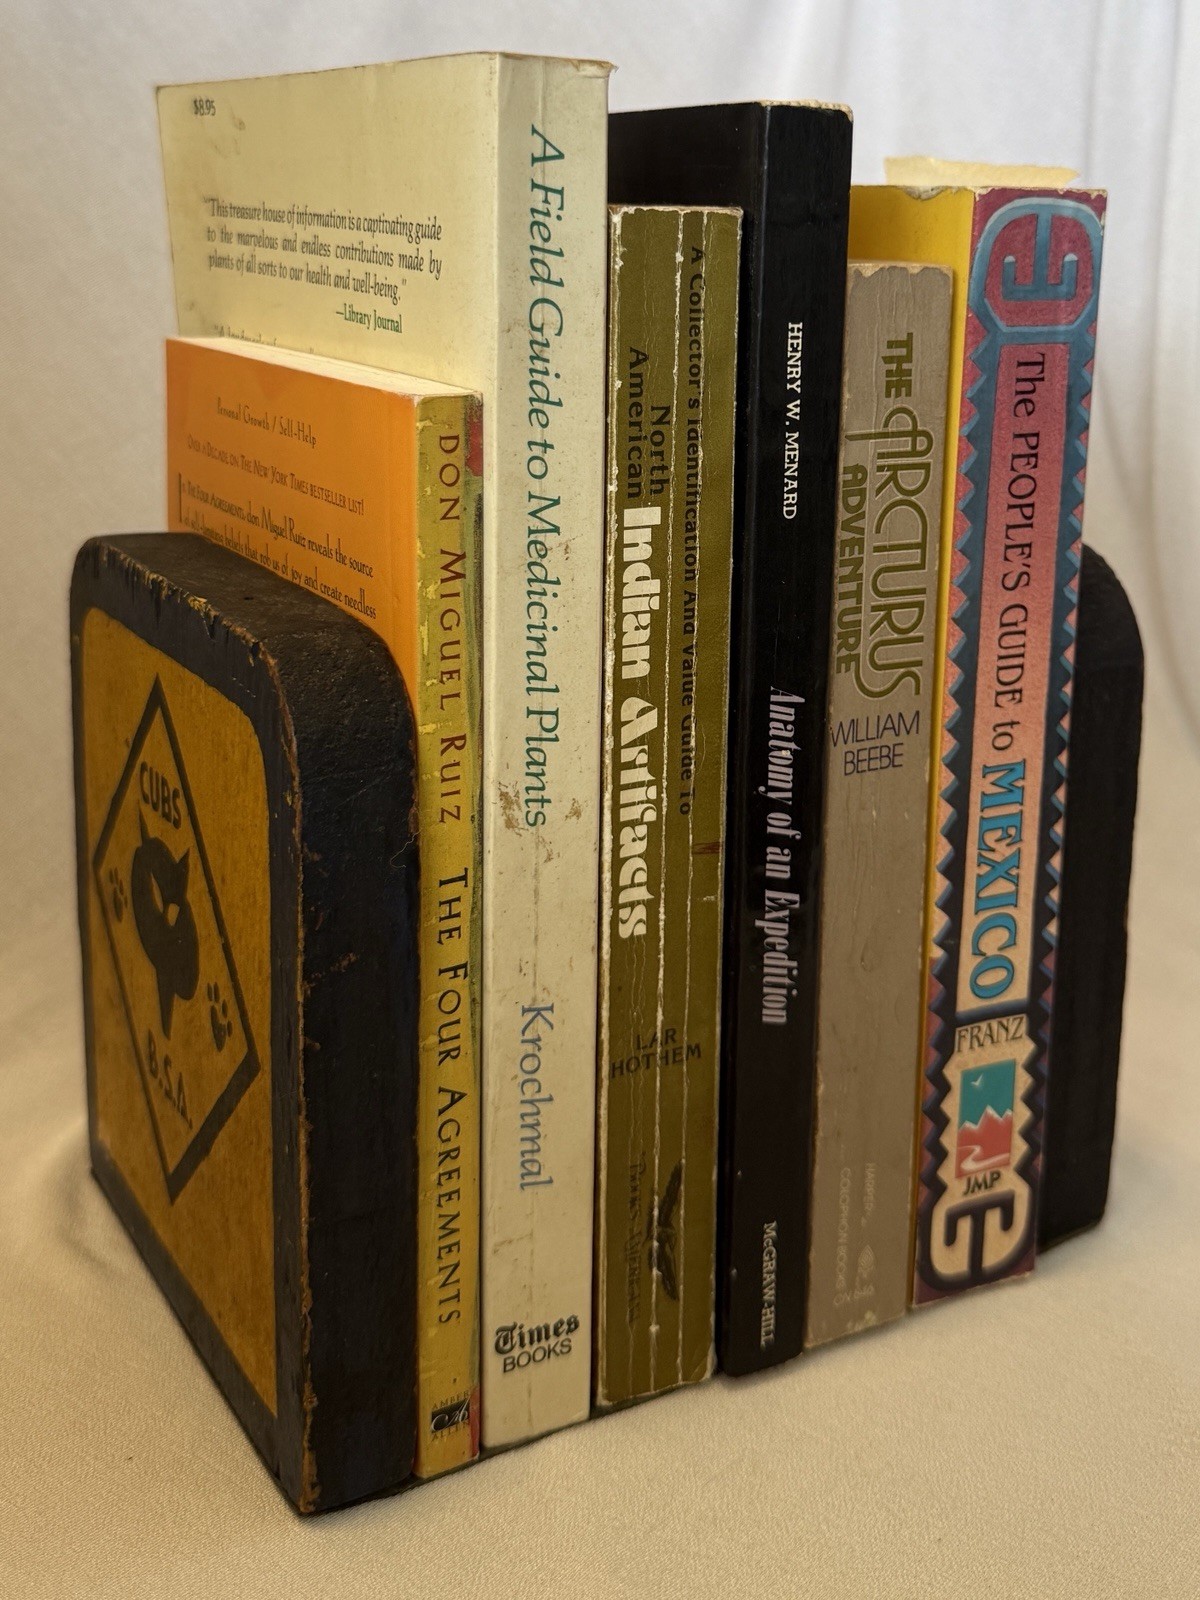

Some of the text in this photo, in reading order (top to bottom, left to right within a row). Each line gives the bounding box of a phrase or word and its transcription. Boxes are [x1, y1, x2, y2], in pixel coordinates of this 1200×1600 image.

[193, 97, 217, 117] $8.95
[229, 202, 262, 221] treasure
[263, 200, 286, 224] house
[287, 204, 296, 230] of
[297, 205, 347, 231] information
[349, 209, 355, 231] is
[357, 216, 362, 231] a
[363, 212, 413, 243] captivating
[415, 216, 442, 245] guide
[206, 224, 442, 280] to the marvelous and endless contributions made by
[208, 249, 407, 305] plants of all sorts to our health and well-being."
[374, 309, 402, 333] Journal
[688, 273, 706, 409] Collector's
[243, 404, 270, 430] Growth
[280, 416, 317, 449] Self-Help
[650, 404, 672, 496] North
[310, 483, 346, 508] BESTSELLER
[348, 497, 365, 515] LIST!
[525, 123, 565, 828] A Field Guide to Medicinal Plants
[247, 501, 261, 528] don
[261, 506, 288, 541] Miguel
[289, 517, 307, 548] Ruiz
[308, 533, 334, 559] reveals
[335, 538, 348, 566] the
[349, 557, 375, 578] source
[844, 332, 935, 699] THE ARCTURUS
[304, 566, 319, 591] and
[320, 581, 343, 602] create
[344, 588, 378, 620] needless
[836, 464, 868, 675] ADVENTURE
[618, 347, 661, 939] American Indian Artifacts
[755, 322, 805, 1025] HENRY W. MENARD Anatomy of an Expedition
[969, 352, 1046, 1000] The PEOPLE'S GUIDE to MEXICO
[831, 710, 921, 747] WILLIAM
[843, 742, 904, 776] BEEBE
[140, 761, 182, 830] CUBS
[436, 434, 469, 1324] DON MIGUEL RUIZ THE FOUR AGREEMENTS
[610, 1042, 702, 1079] HOTHEM
[636, 1027, 678, 1051] LAR
[955, 1013, 1026, 1055] FRANZ
[519, 1003, 555, 1192] Krochmal
[962, 1170, 1001, 1198] JMP
[494, 1313, 580, 1355] Times
[502, 1337, 573, 1374] BOOKS
